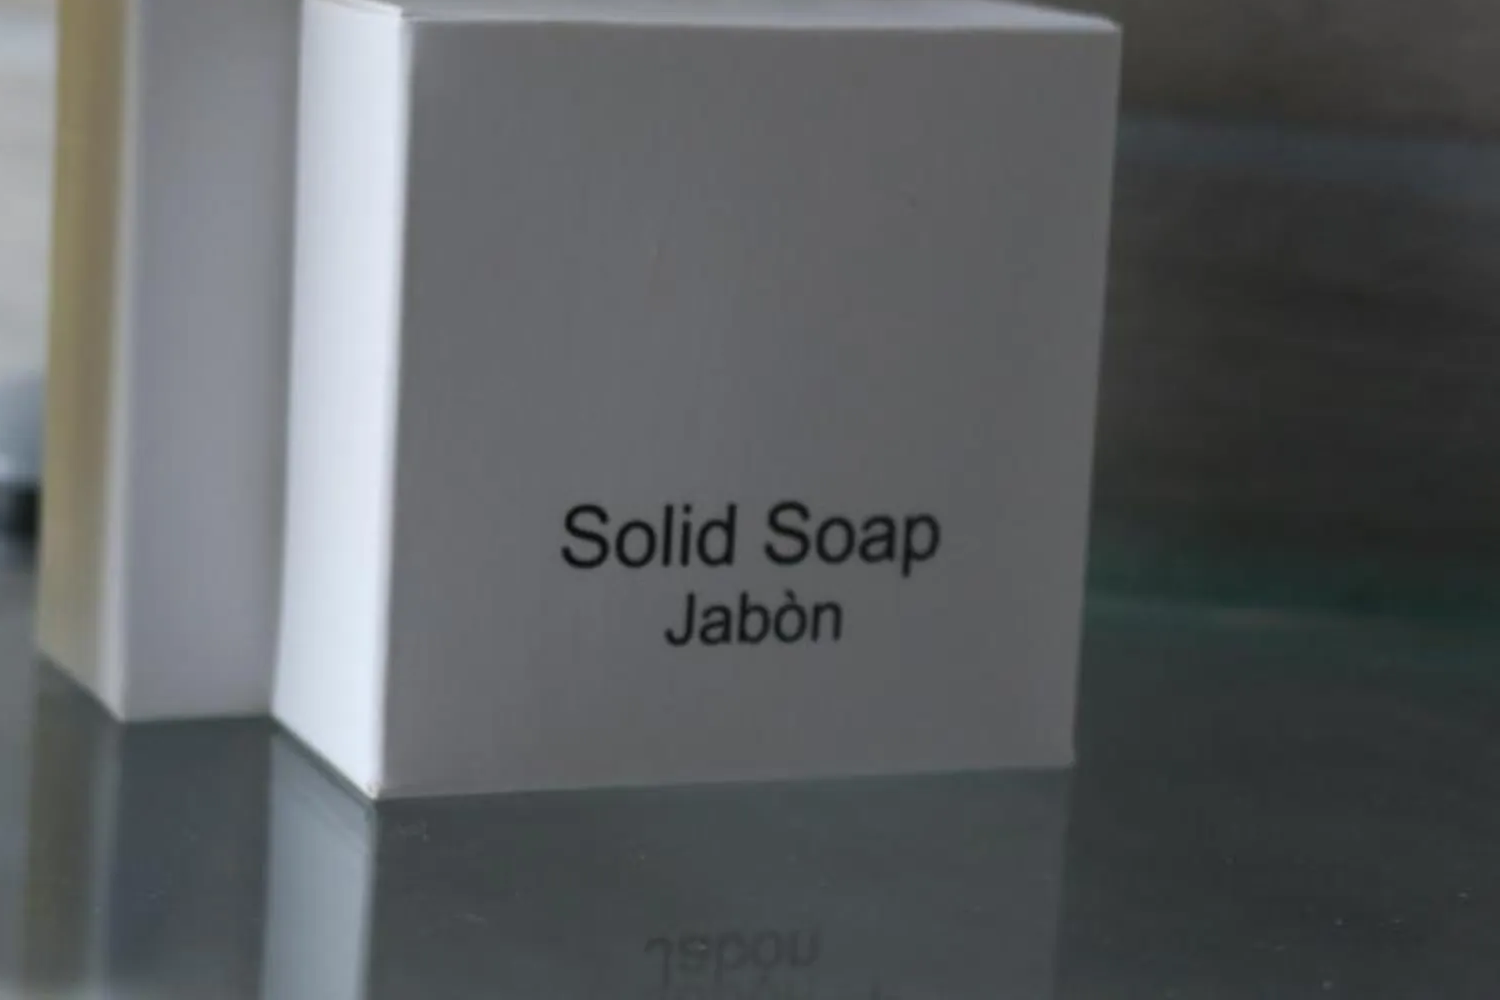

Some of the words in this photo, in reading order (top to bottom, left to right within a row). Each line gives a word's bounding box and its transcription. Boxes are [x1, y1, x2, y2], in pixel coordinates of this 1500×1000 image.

[561, 503, 737, 568] Solid
[764, 501, 942, 578] Soap
[664, 590, 843, 647] Jabòn
